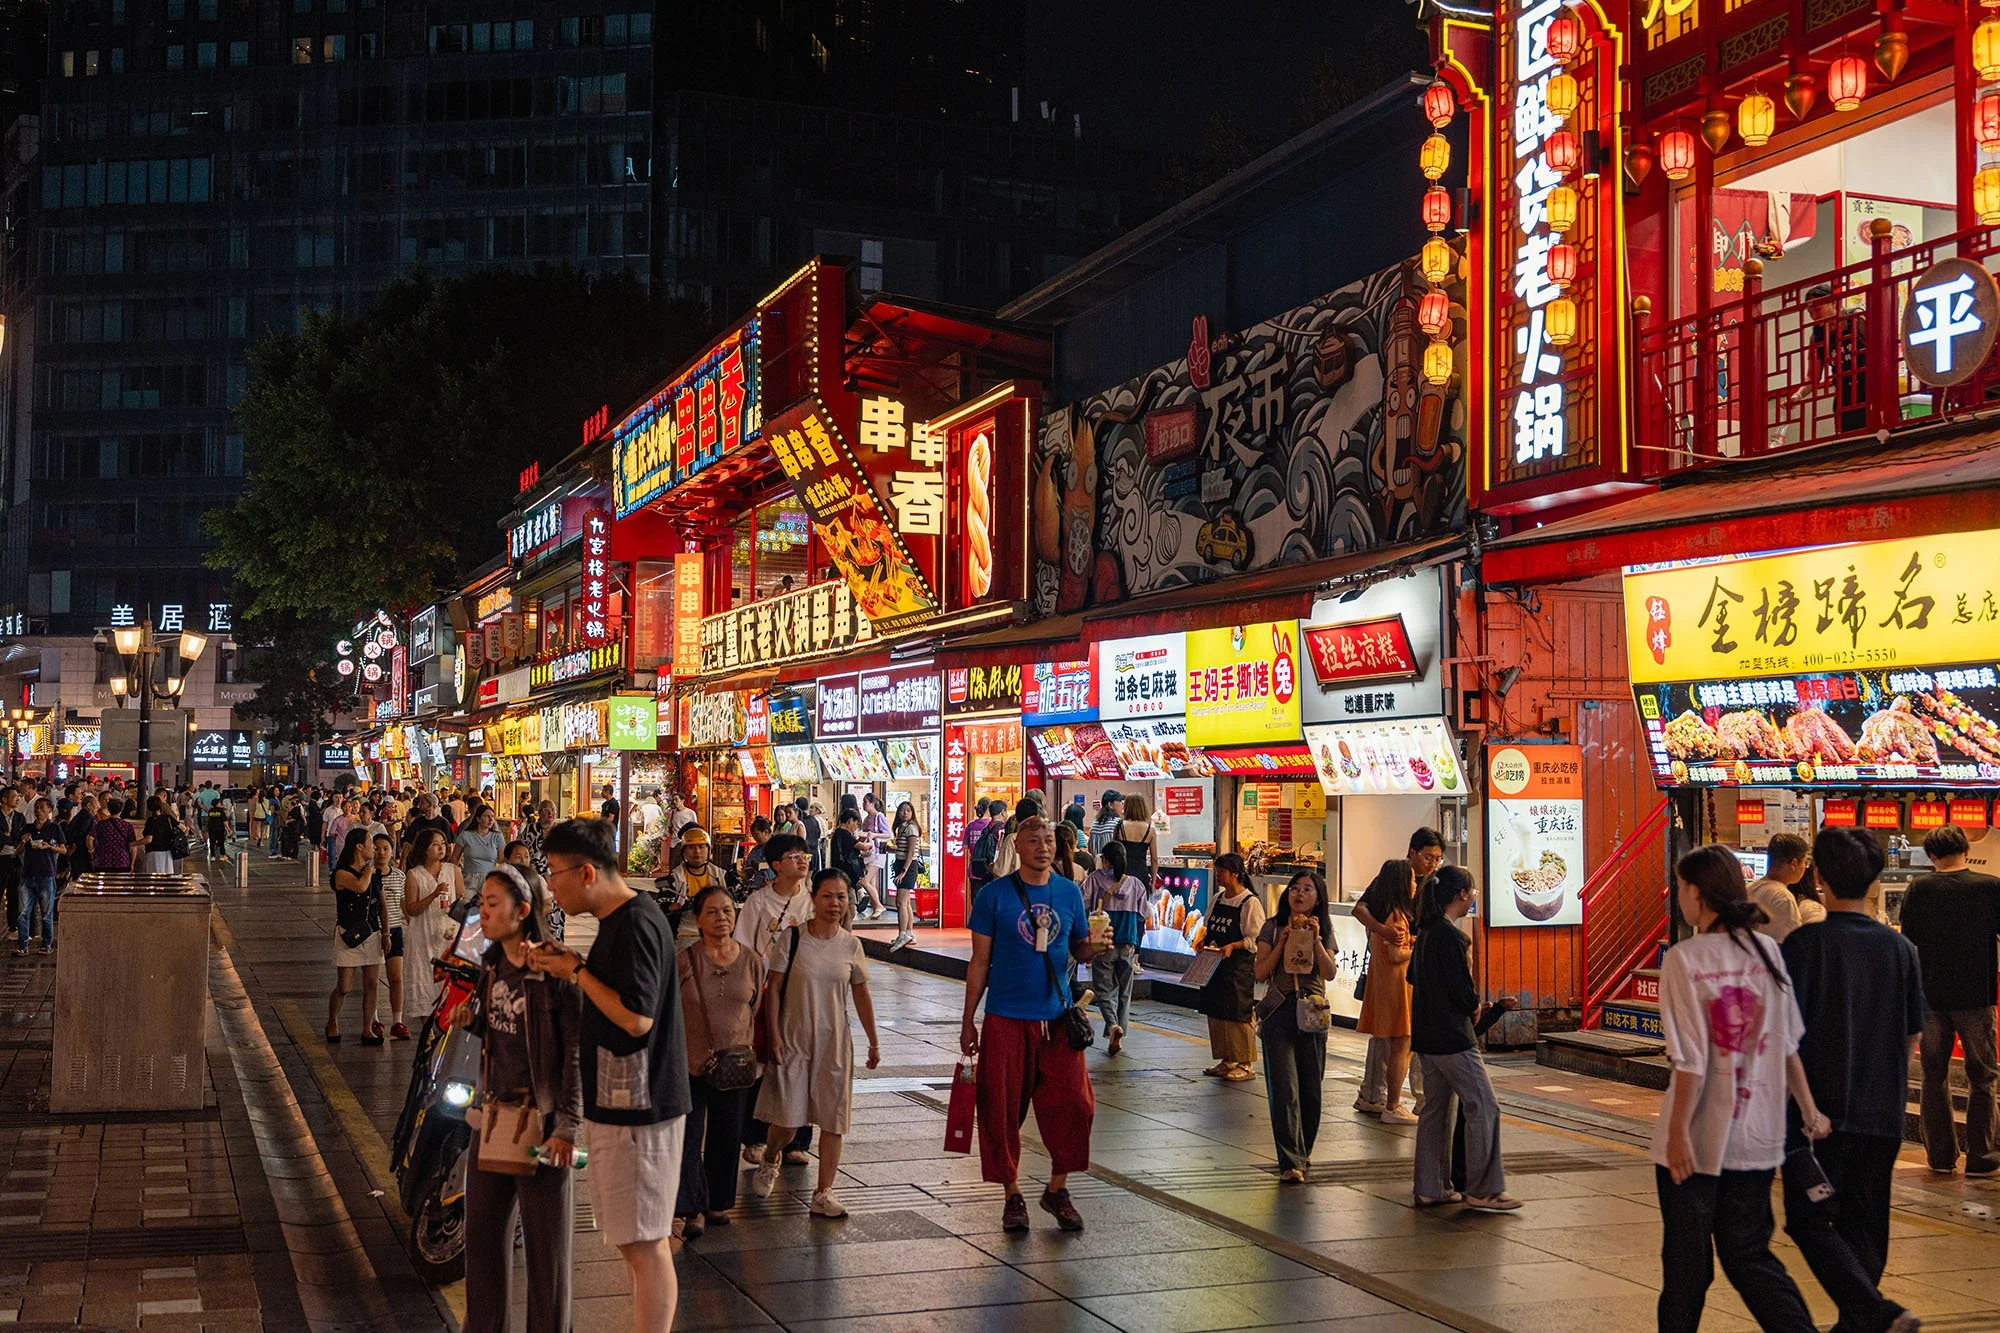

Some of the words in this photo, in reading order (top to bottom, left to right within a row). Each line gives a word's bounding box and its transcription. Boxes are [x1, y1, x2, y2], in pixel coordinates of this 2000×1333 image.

[1515, 0, 1566, 464] 区鲜货老火锅
[1909, 273, 1982, 373] 平
[770, 414, 839, 480] 串串香
[588, 517, 607, 638] 九宫格老火锅
[680, 561, 700, 643] 串串香
[1698, 551, 1935, 654] 金榜蹄名
[1313, 631, 1402, 674] 拉丝凉糕
[1803, 648, 1896, 667] 400-023-5550
[1039, 670, 1091, 715] 脆五花
[1344, 691, 1395, 714] 地道重庆味
[193, 745, 228, 756] 山丘酒店
[947, 738, 965, 793] 太酥了
[1533, 761, 1579, 775] 重庆必吃榜
[947, 801, 965, 857] 真好吃
[1637, 980, 1658, 998] 社区
[1605, 1010, 1638, 1031] 好吃不贵
